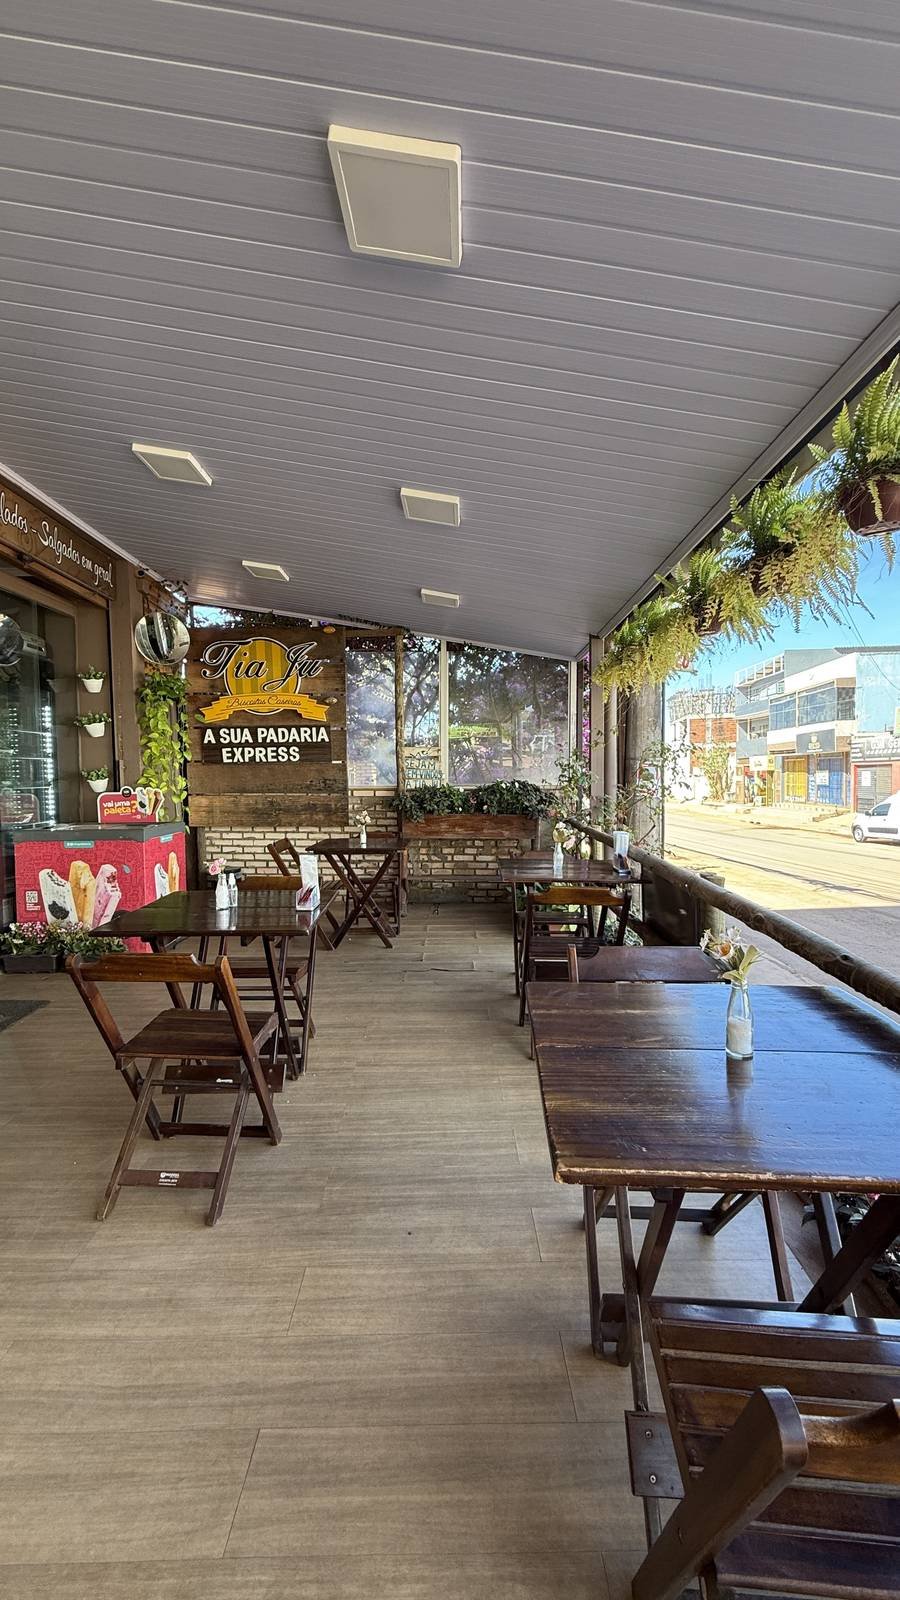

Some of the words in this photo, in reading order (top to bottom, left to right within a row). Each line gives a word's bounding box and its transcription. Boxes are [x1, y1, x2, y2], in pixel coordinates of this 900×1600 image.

[37, 520, 81, 565] Salgados
[81, 555, 93, 573] em
[93, 562, 114, 588] geral
[201, 639, 268, 679] Tia
[262, 641, 324, 693] Ju
[203, 728, 216, 744] A
[219, 727, 254, 744] SUA
[257, 726, 330, 743] PADARIA
[221, 746, 300, 763] EXPRESS
[102, 800, 114, 808] vai
[115, 800, 130, 808] uma
